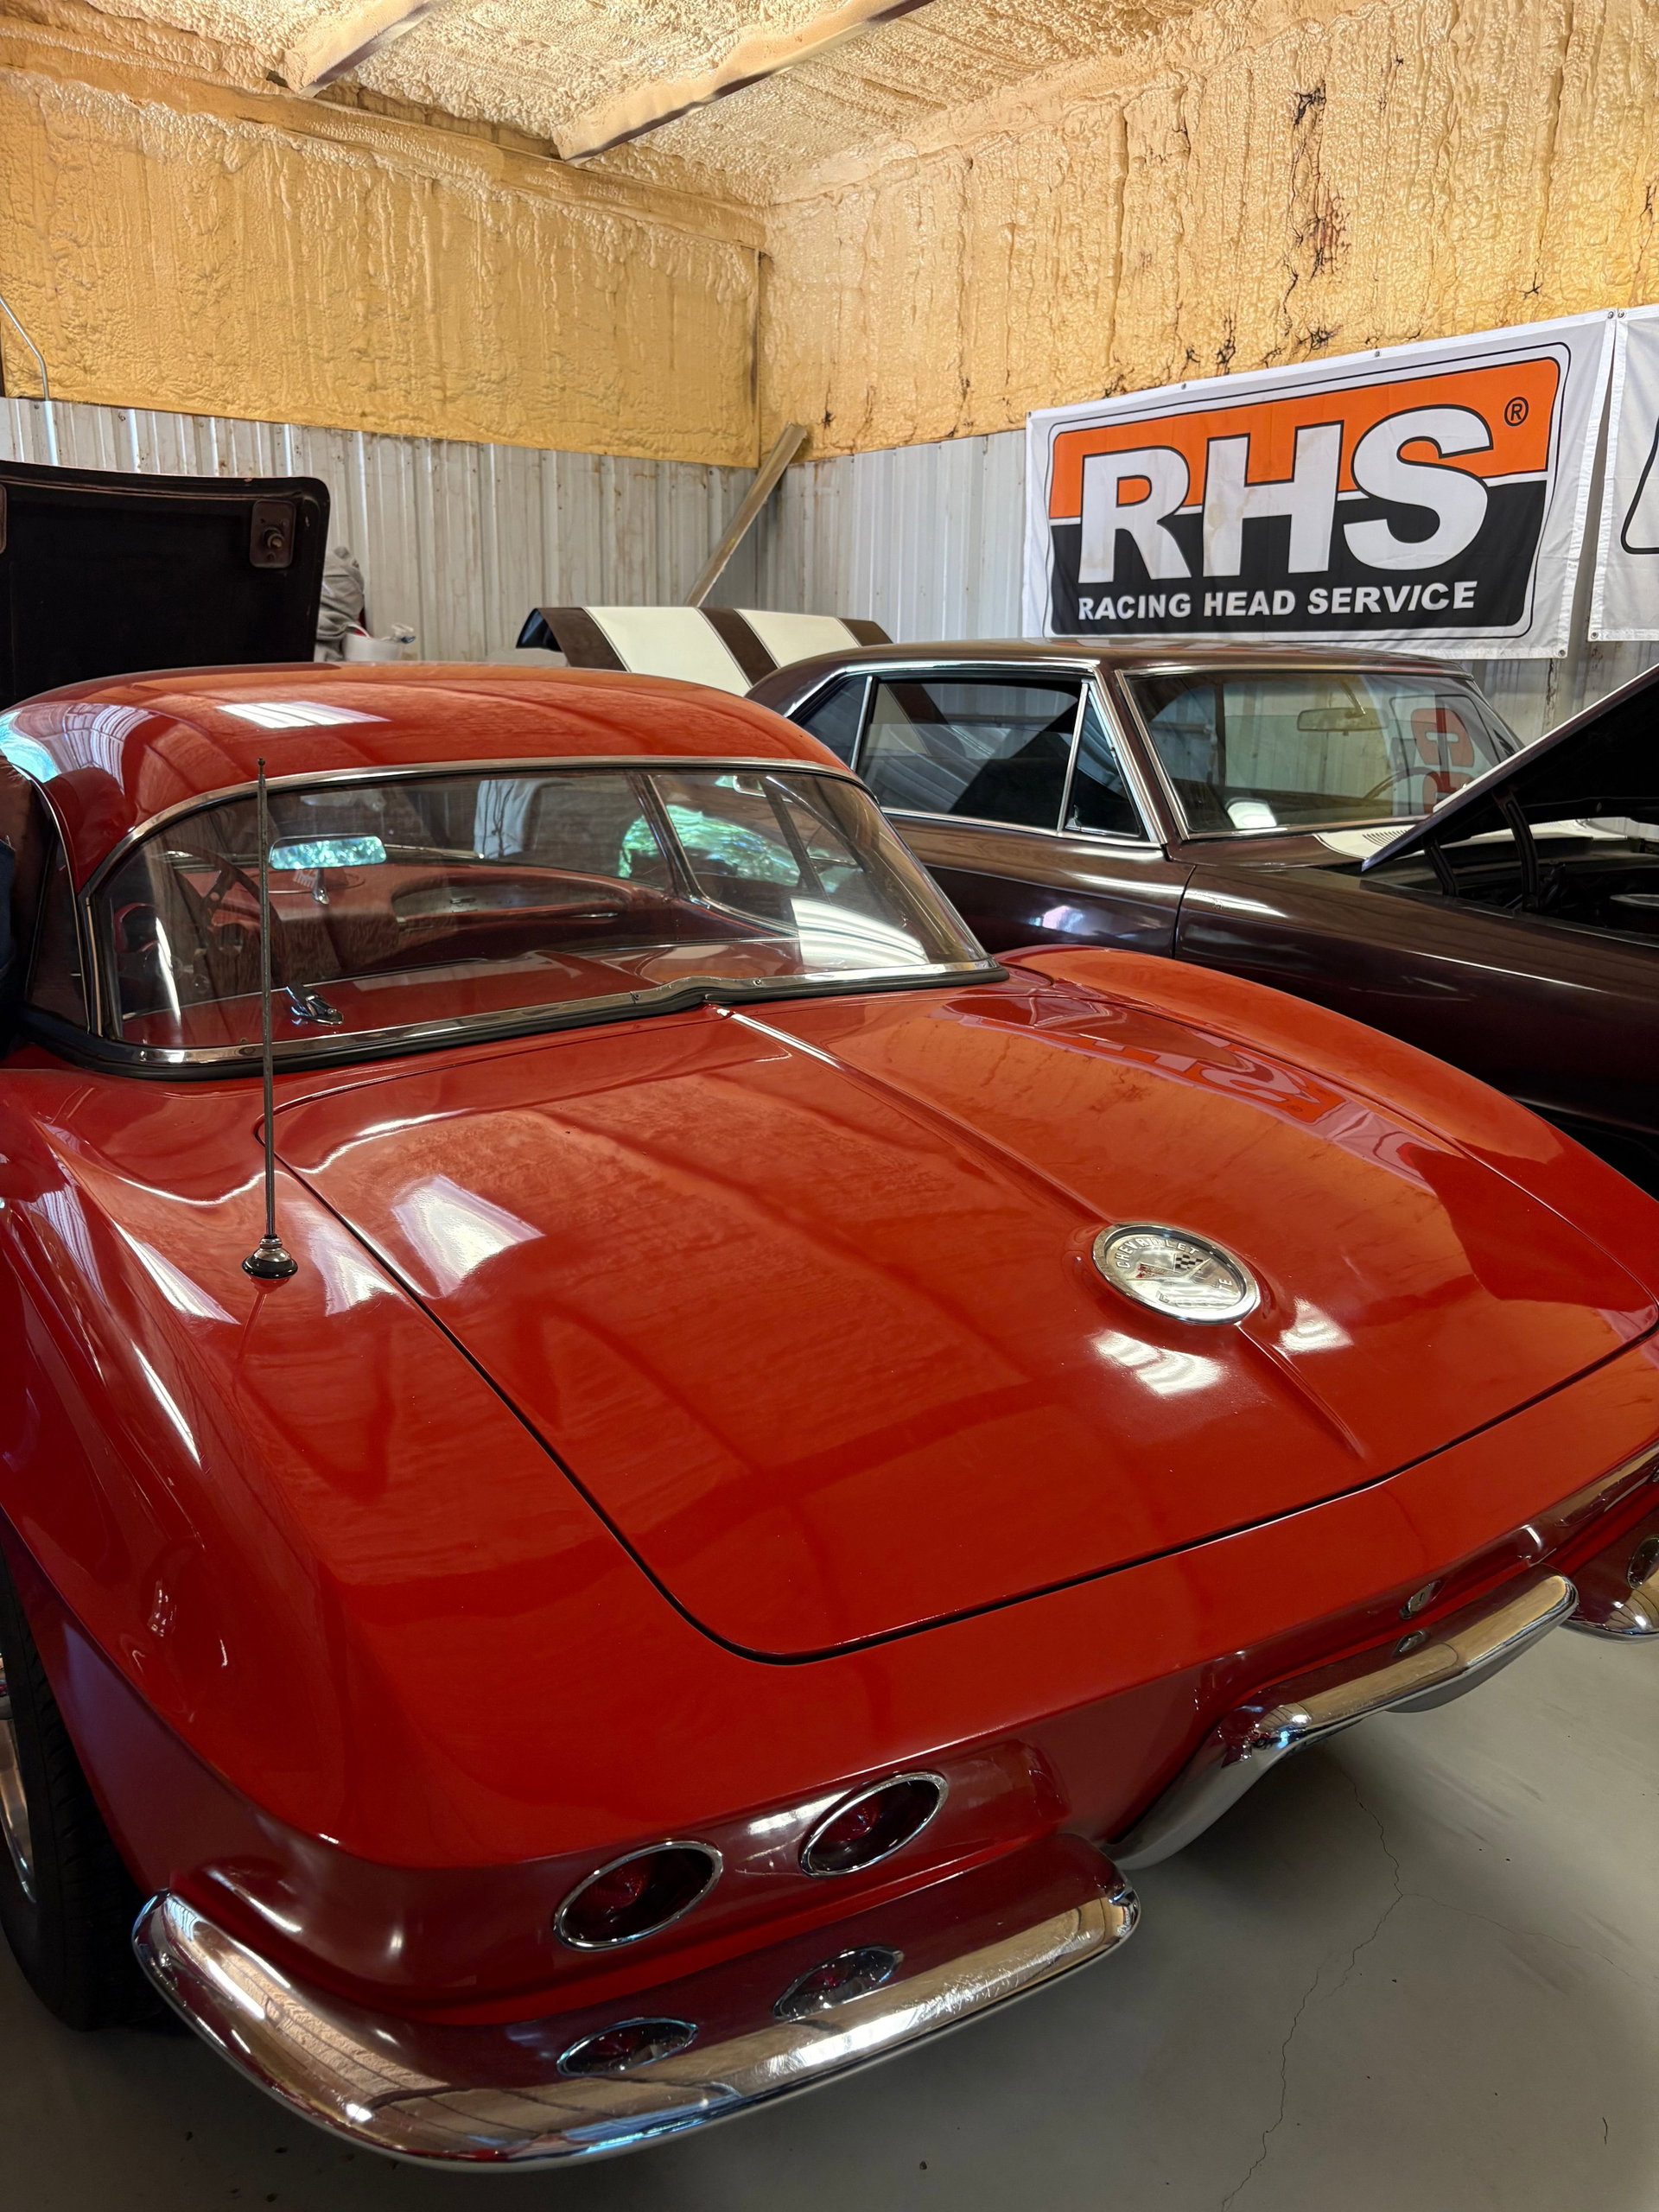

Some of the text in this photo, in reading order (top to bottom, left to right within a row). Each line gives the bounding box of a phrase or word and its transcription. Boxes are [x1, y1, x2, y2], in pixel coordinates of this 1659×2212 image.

[1077, 406, 1494, 584] RHS
[1078, 581, 1478, 620] RACING HEAD SERVICE
[1115, 1236, 1200, 1269] CHEVROLET
